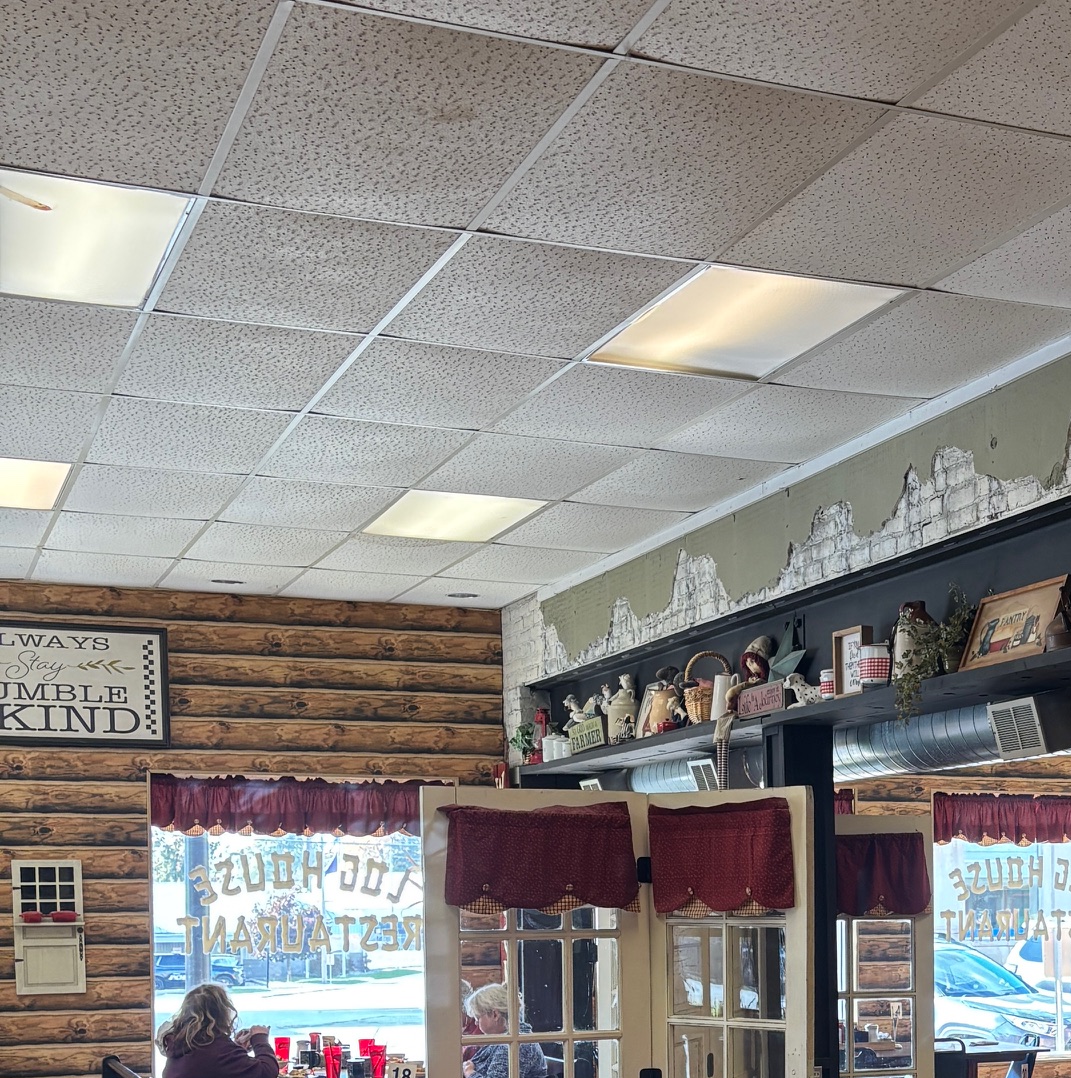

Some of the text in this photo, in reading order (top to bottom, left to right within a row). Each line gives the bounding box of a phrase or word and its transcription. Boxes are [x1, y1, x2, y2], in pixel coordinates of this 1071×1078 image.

[1000, 610, 1027, 627] PANTRY
[5, 650, 67, 681] Stay
[0, 703, 141, 734] KIND
[571, 729, 602, 751] FARMER
